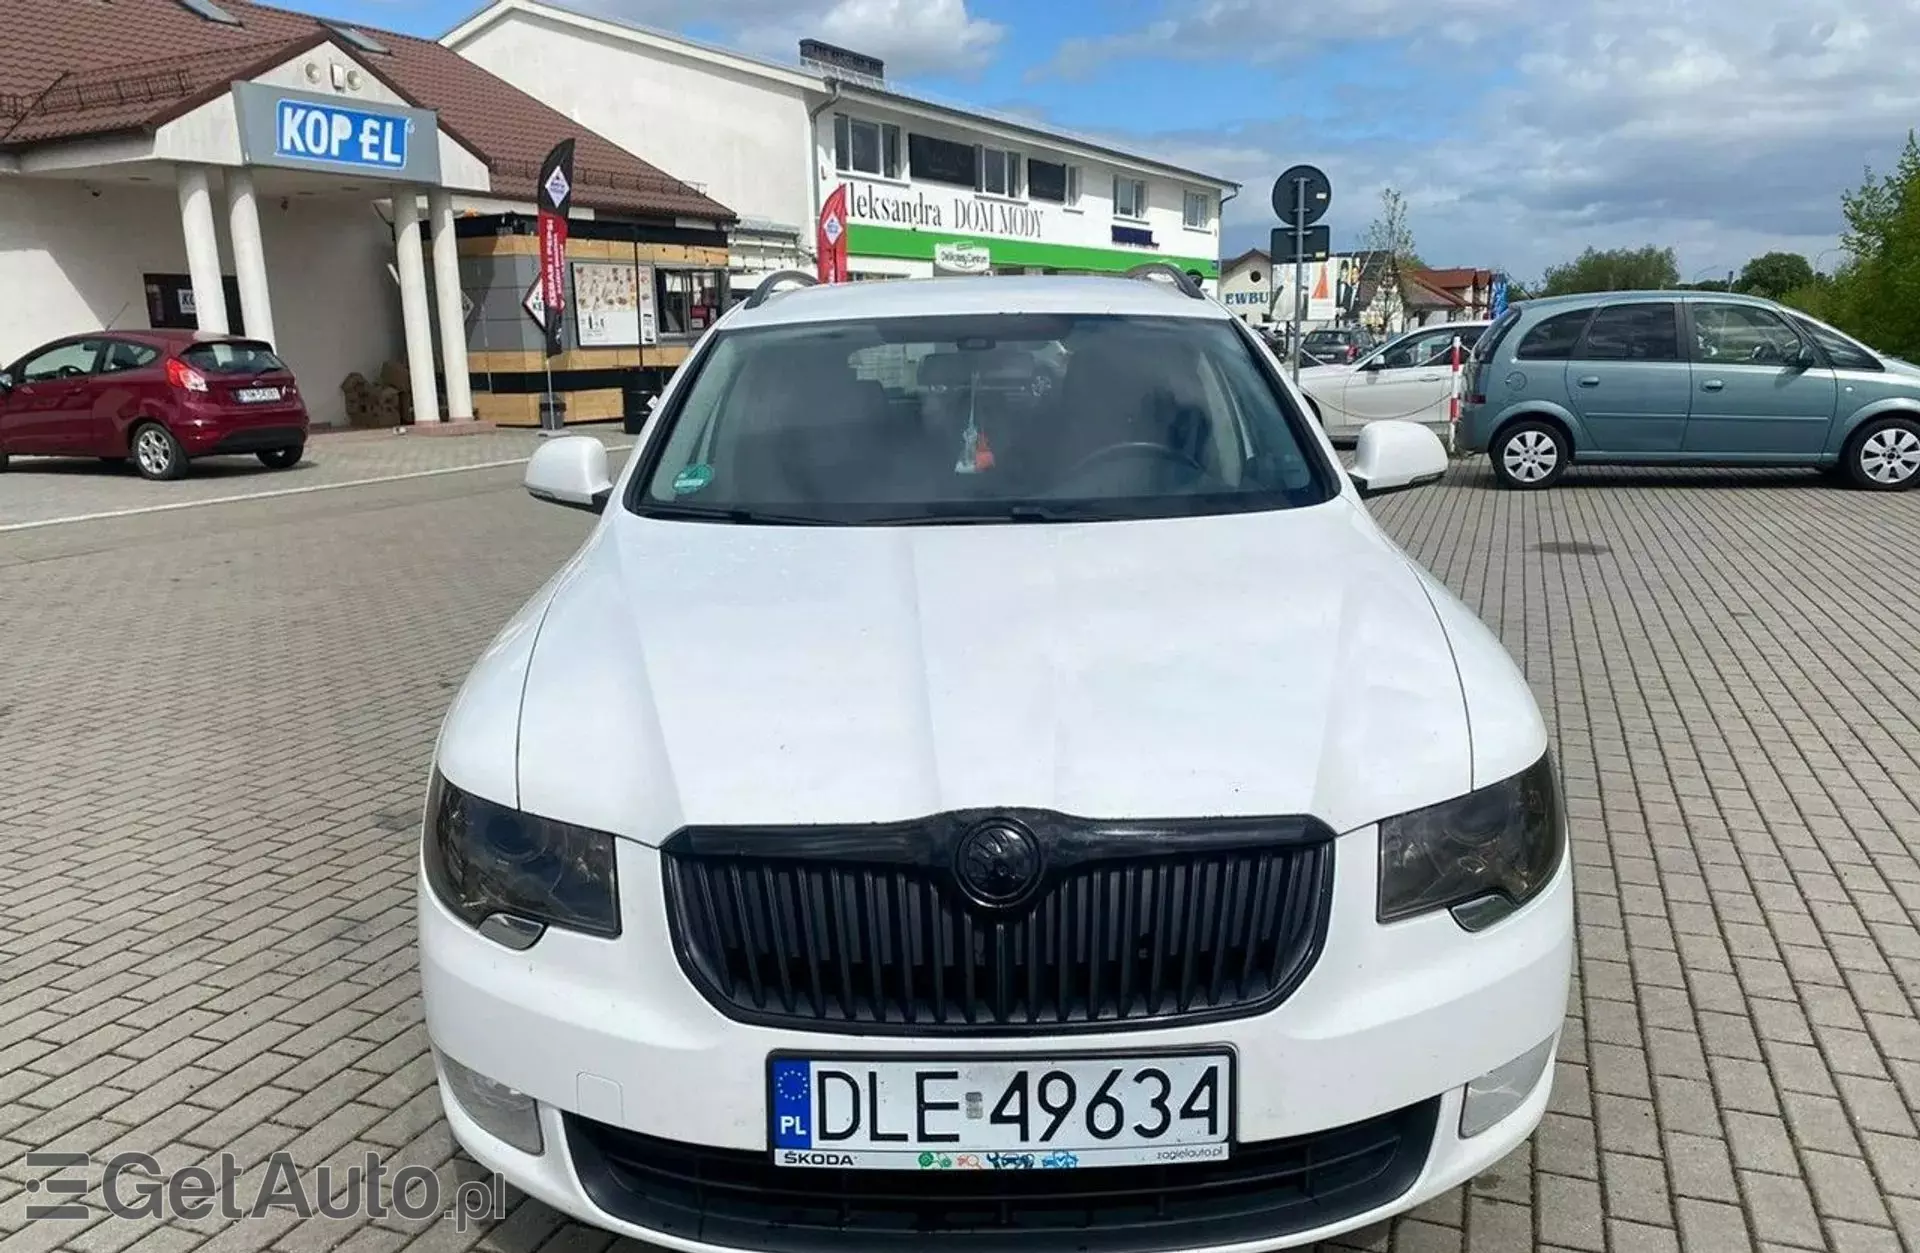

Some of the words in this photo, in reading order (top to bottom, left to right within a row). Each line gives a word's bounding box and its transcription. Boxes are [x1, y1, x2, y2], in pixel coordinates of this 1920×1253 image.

[846, 182, 942, 227] leksandra
[954, 198, 994, 232] DOM
[999, 205, 1044, 238] MODY
[818, 1070, 960, 1142] DLE
[989, 1065, 1218, 1143] 49634
[780, 1115, 807, 1135] PL
[783, 1150, 854, 1166] ŠKODA
